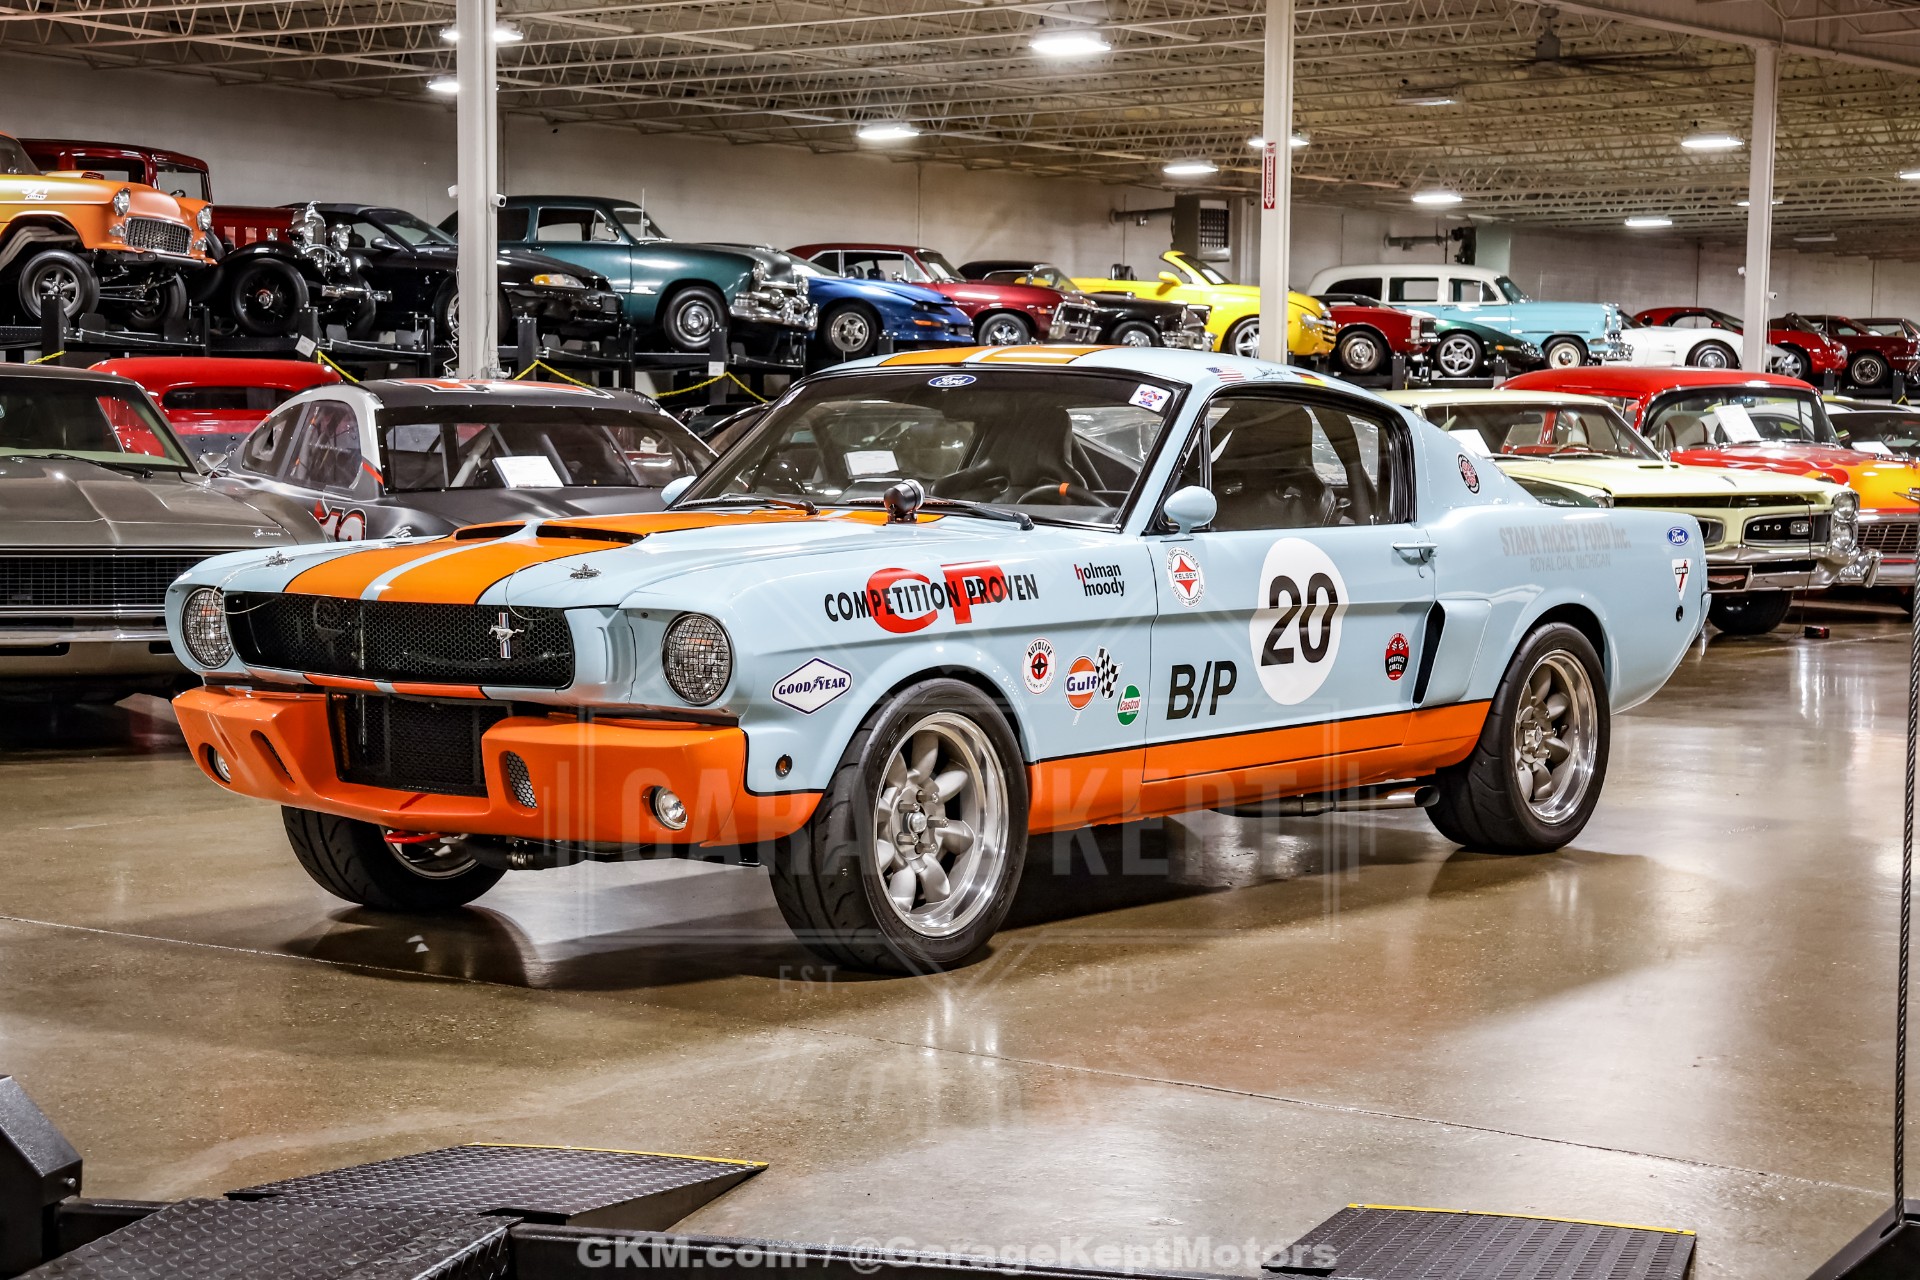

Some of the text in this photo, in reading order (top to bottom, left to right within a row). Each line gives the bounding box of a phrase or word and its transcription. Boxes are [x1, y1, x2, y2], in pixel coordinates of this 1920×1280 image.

[1499, 525, 1541, 557] STARK
[1580, 520, 1611, 551] FORD
[1609, 520, 1632, 549] Inc.
[1752, 524, 1782, 532] GTO
[1073, 562, 1122, 584] holman
[1530, 556, 1556, 573] ROYAL
[1576, 552, 1611, 570] MICHIGAN
[1084, 576, 1125, 597] moody
[1174, 572, 1197, 580] KELSEY
[824, 573, 1040, 623] COMPETITION PROVEN
[1260, 572, 1339, 667] 20
[1027, 641, 1053, 659] AUTOLITE
[1066, 675, 1098, 692] Gulf
[1166, 660, 1238, 720] B/P
[1119, 698, 1141, 711] Castrol
